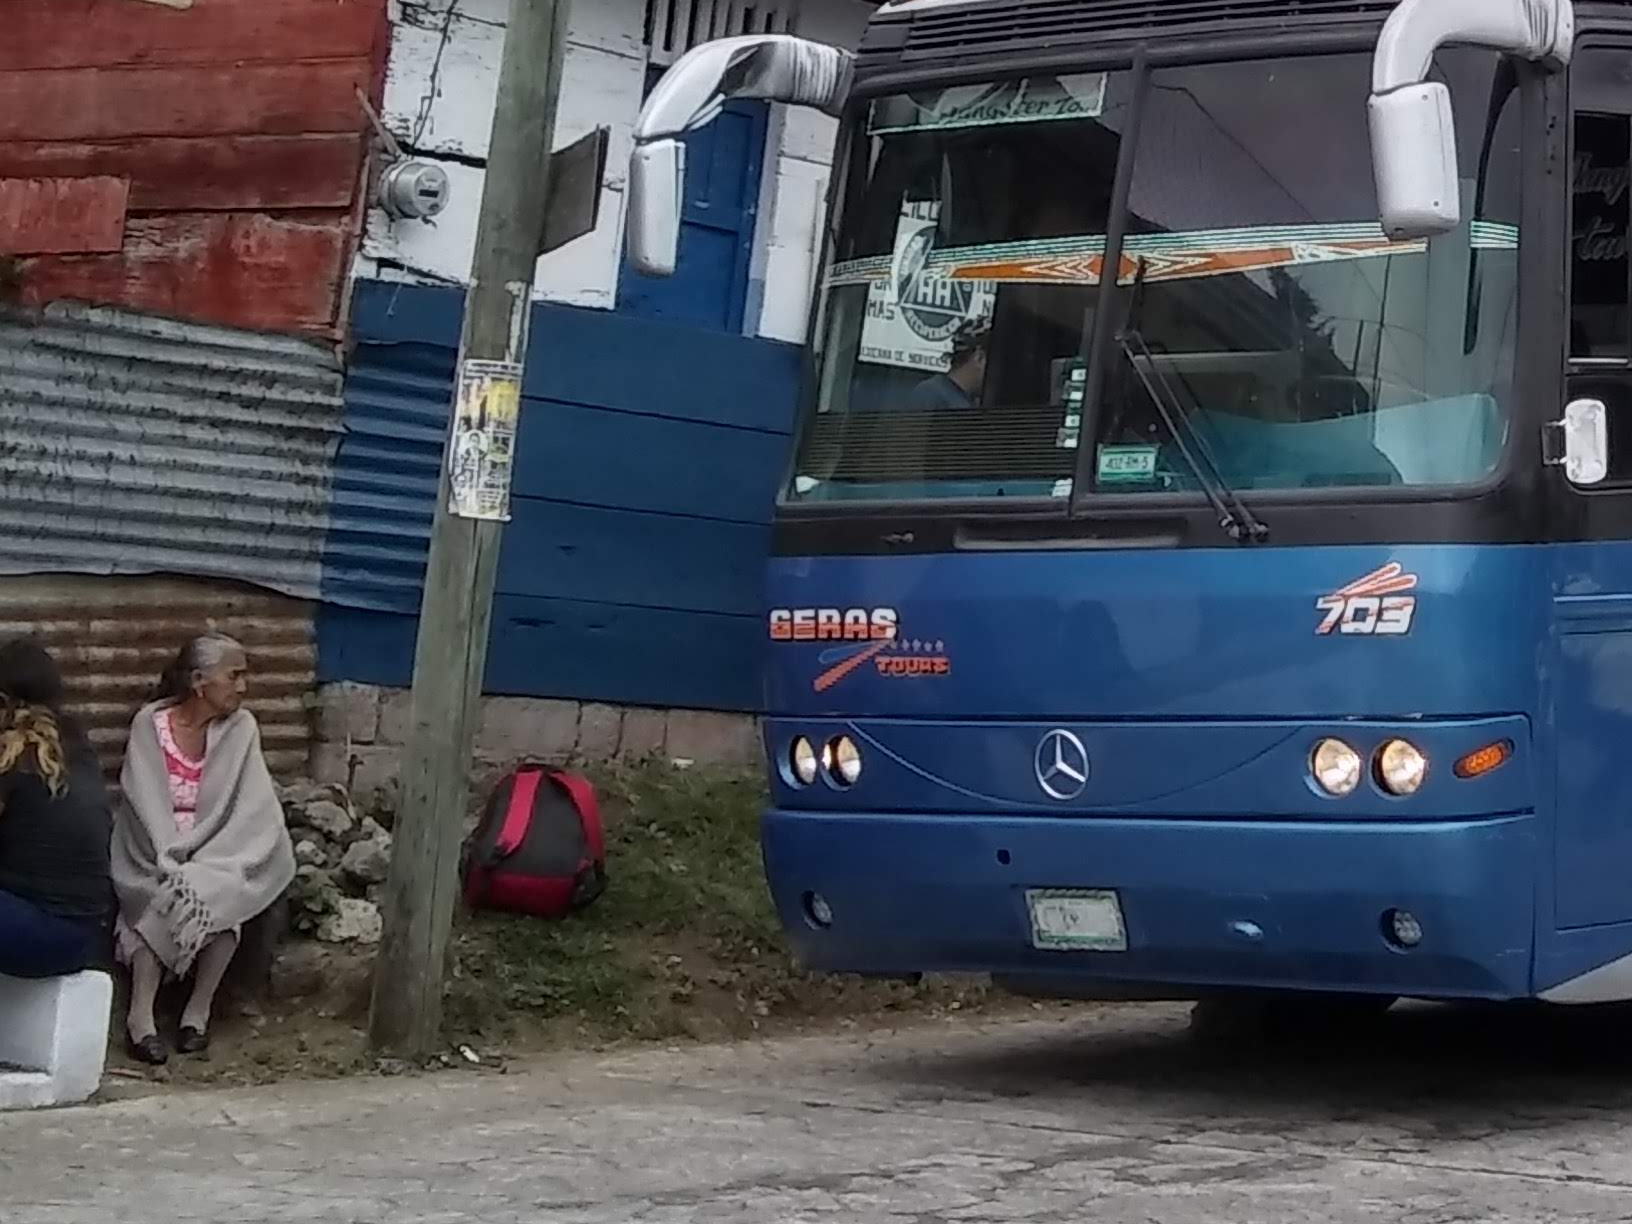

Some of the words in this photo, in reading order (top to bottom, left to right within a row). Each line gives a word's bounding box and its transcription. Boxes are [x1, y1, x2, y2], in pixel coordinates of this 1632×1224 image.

[769, 607, 899, 641] GERAS
[1314, 594, 1416, 635] 703
[874, 655, 951, 677] TOURS
